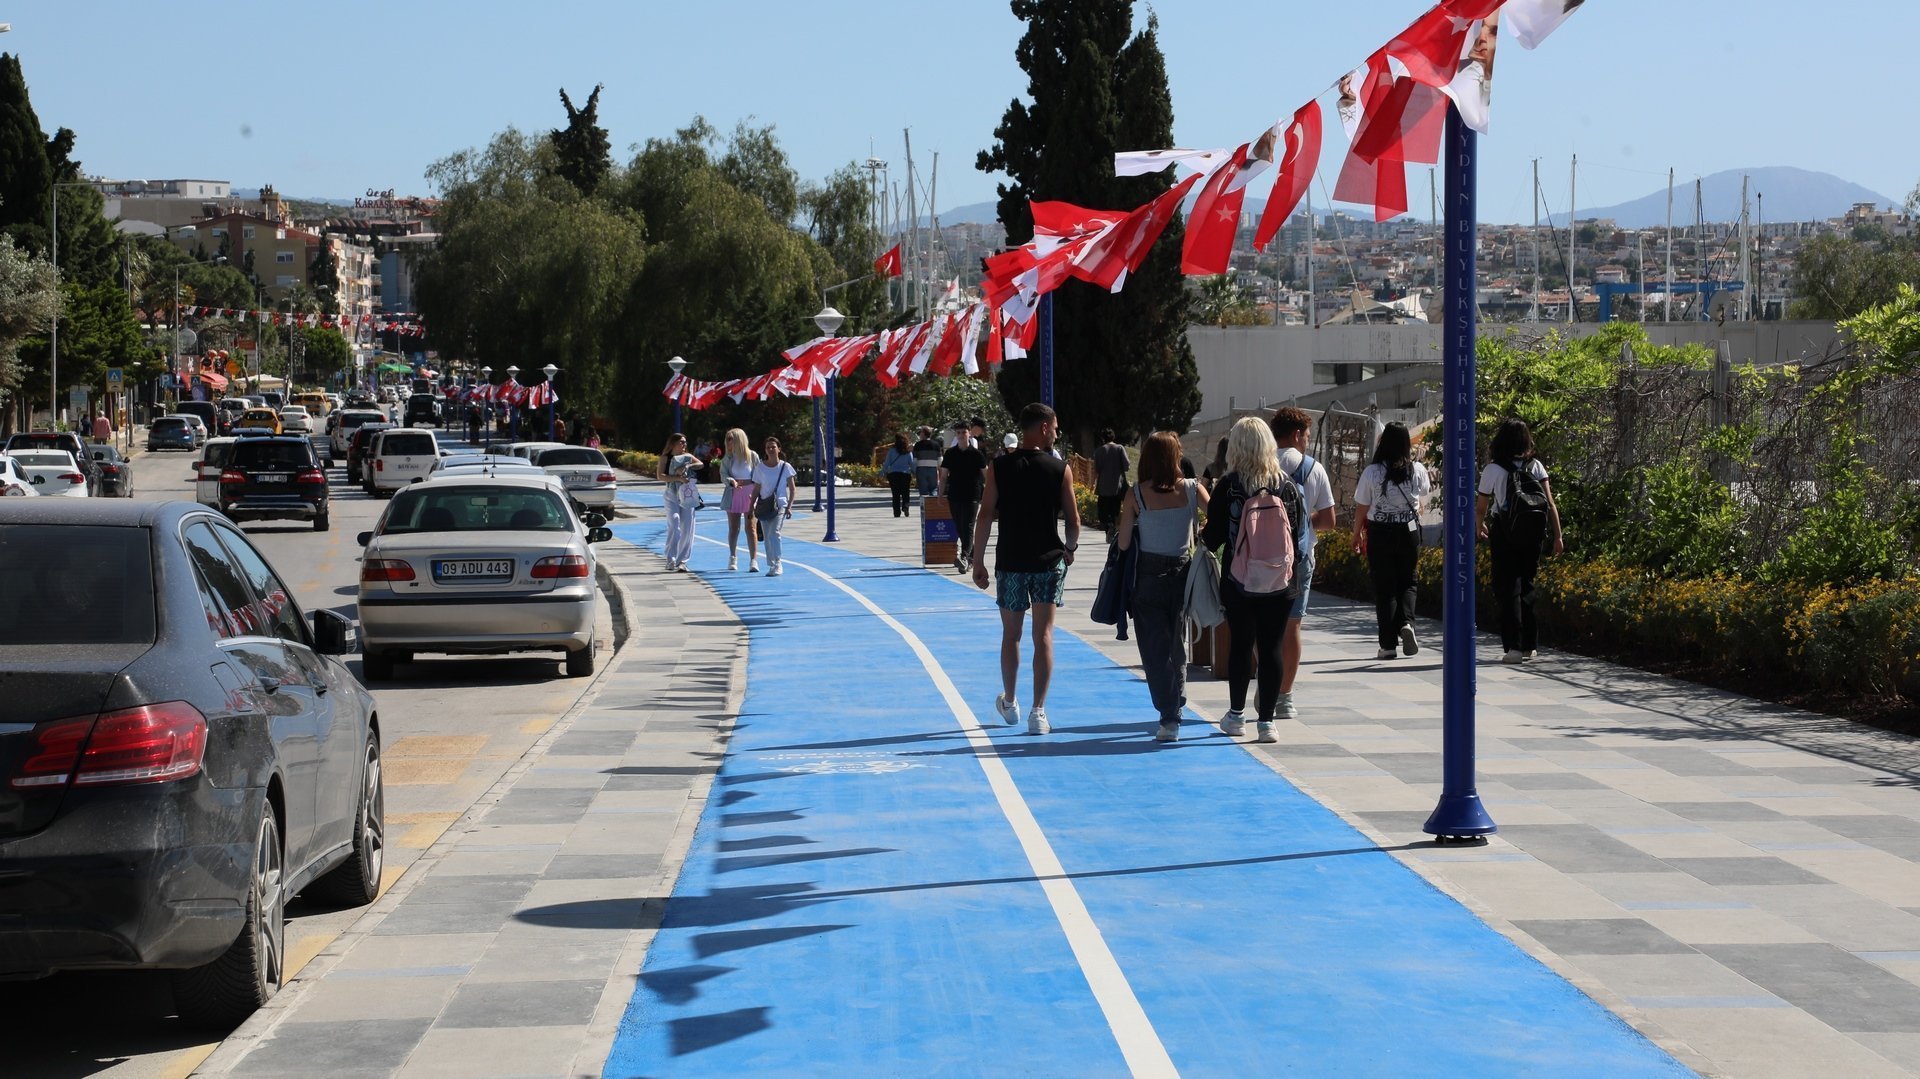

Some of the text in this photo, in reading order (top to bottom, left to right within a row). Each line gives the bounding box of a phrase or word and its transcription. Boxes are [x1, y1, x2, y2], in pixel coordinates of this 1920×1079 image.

[442, 561, 509, 575] 09 ADU 443
